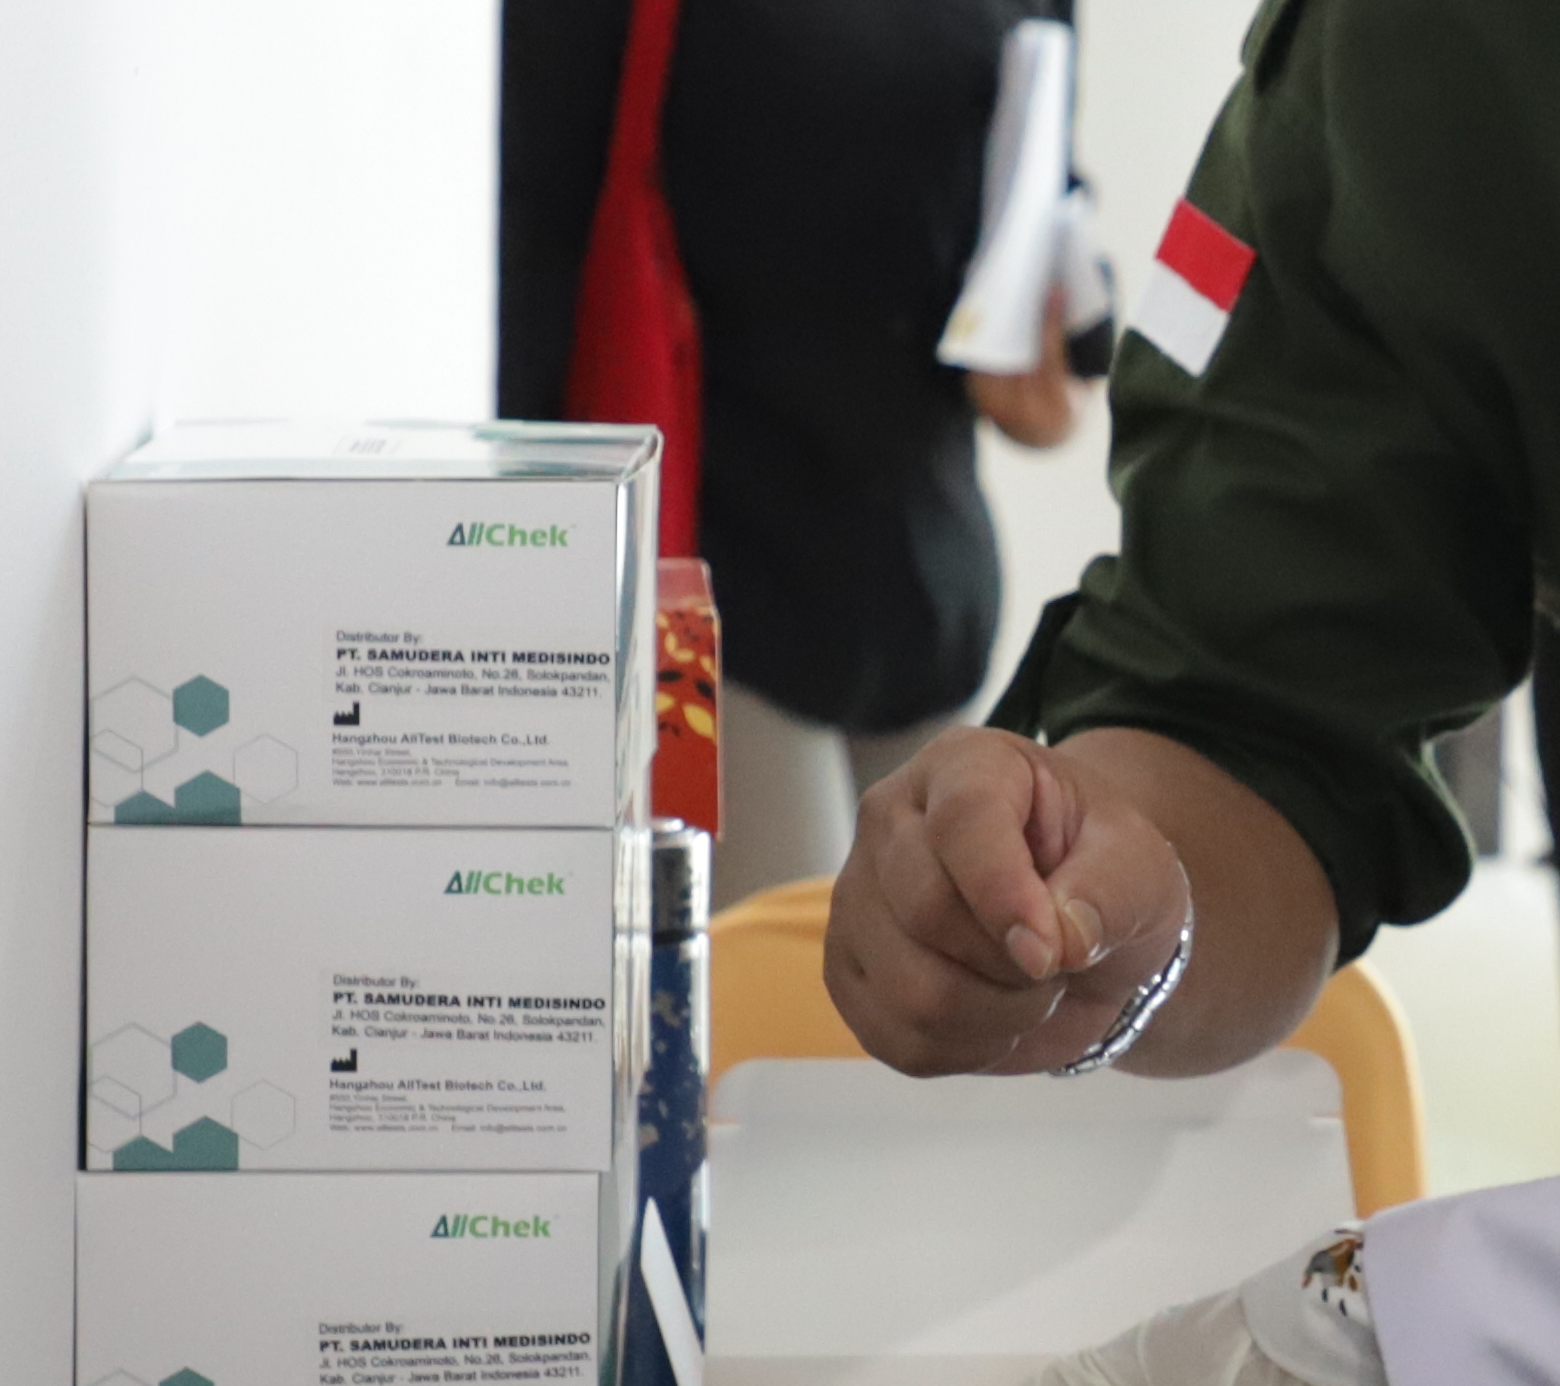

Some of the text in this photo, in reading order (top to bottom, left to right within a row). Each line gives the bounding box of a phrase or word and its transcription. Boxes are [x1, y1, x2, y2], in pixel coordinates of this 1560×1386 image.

[336, 648, 610, 664] PT. SAMUDERA INTI MEDISINDO
[424, 684, 457, 695] Jawa
[461, 684, 494, 696] Barat
[333, 992, 606, 1009] PT. SAMUDERA INTI MEDISINDO
[420, 1028, 452, 1039] Jawa
[457, 1028, 490, 1040] Barat
[319, 1332, 590, 1352] PT. SAMUDERA INTI MEDISINDO
[408, 1371, 439, 1382] Jawa
[444, 1370, 476, 1381] Barat
